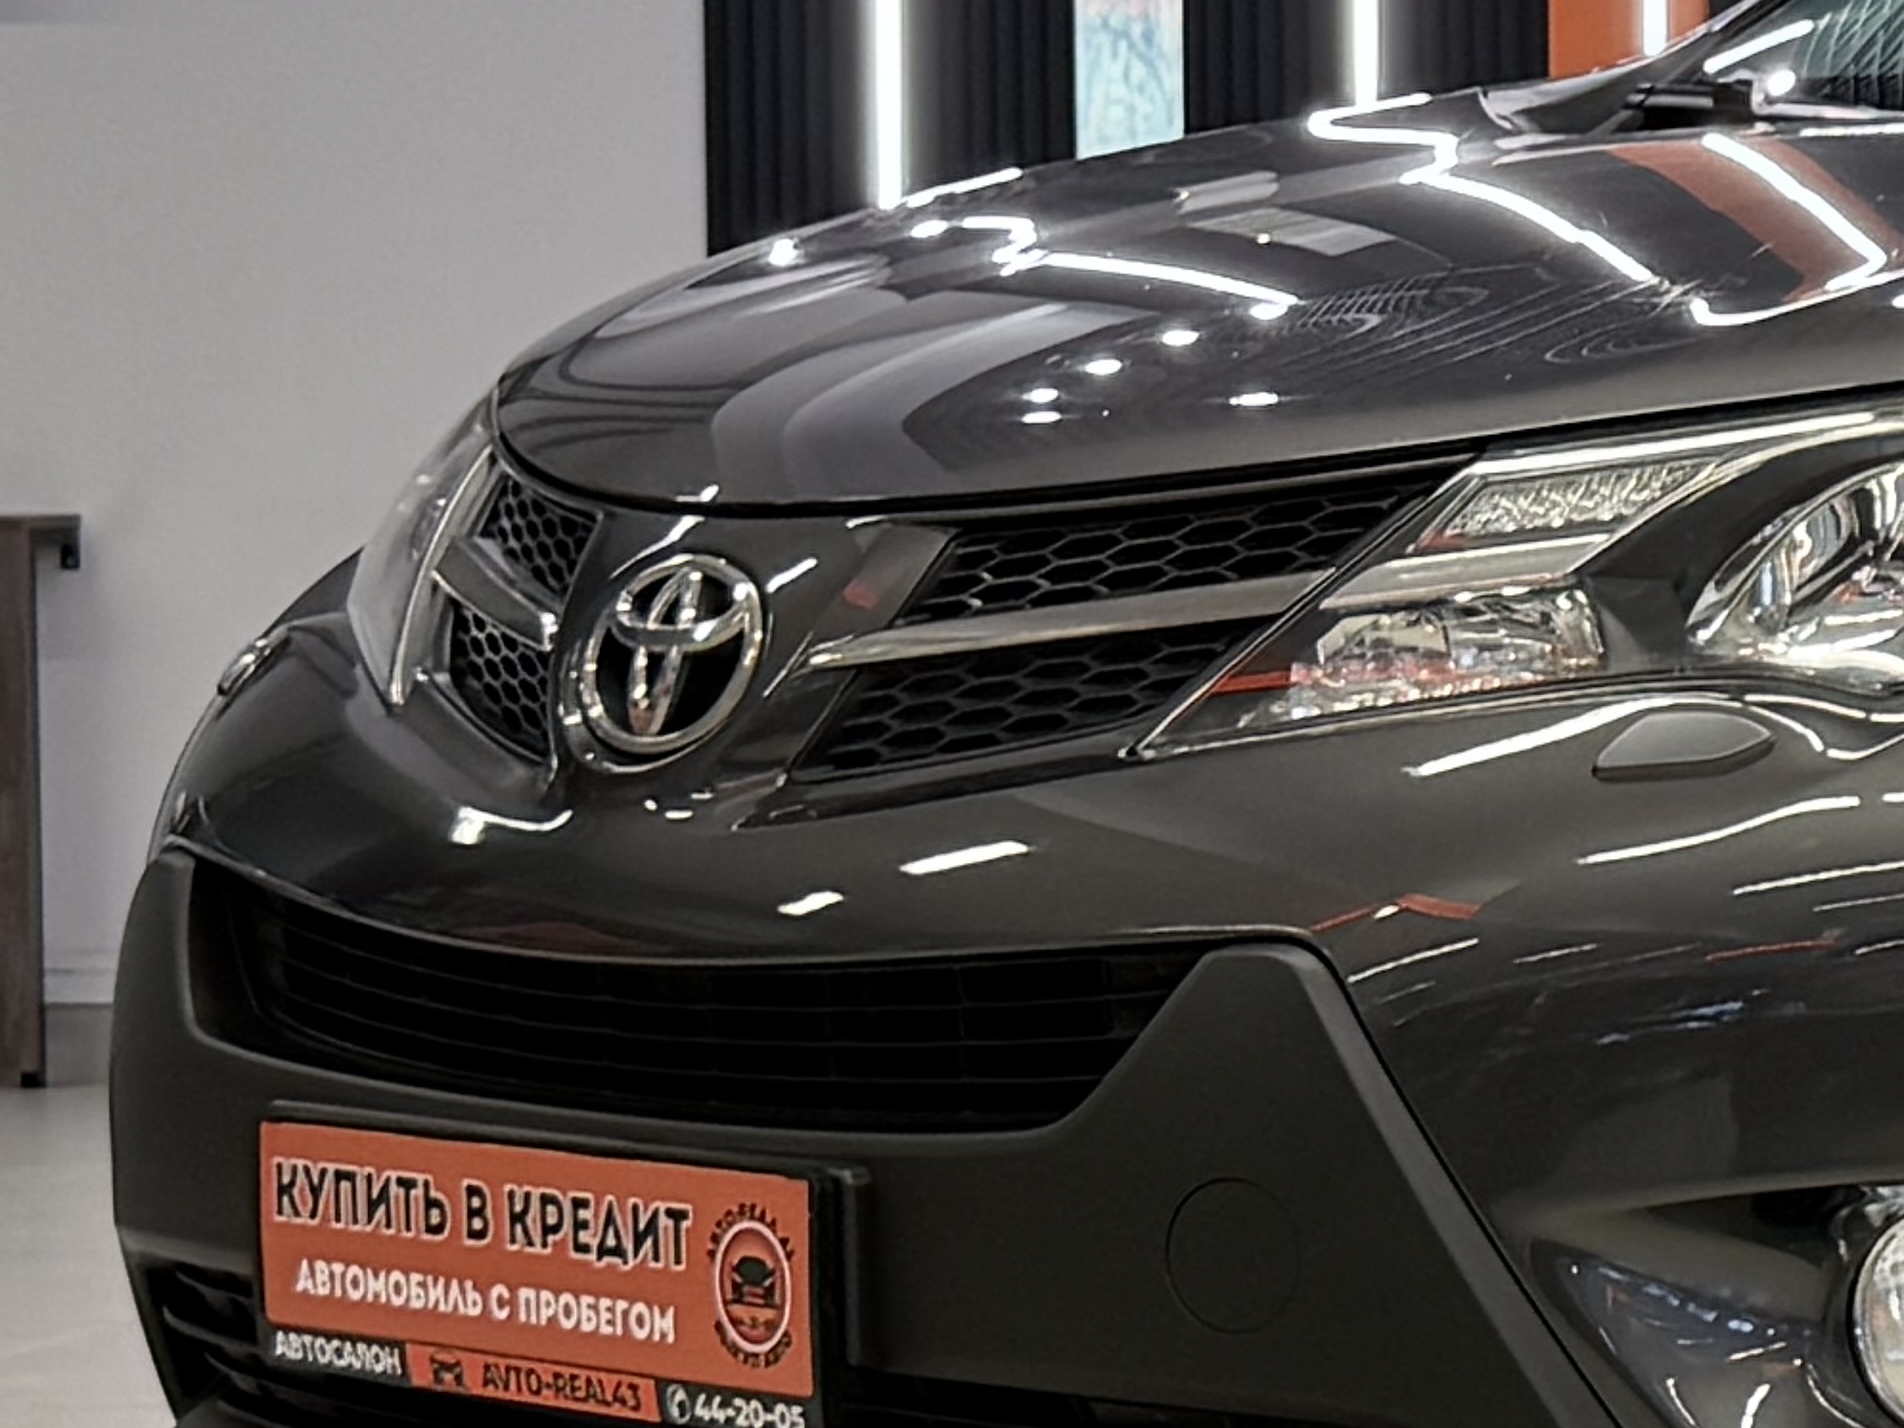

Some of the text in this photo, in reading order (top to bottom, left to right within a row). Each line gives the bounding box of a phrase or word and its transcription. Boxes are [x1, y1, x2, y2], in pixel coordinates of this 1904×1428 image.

[274, 1158, 451, 1240] КУПИТЬ
[462, 1178, 492, 1245] В
[503, 1183, 692, 1270] КРЕДИТ
[296, 1259, 675, 1343] АВТОМОБИЛЬ С ПРОБЕГОМ
[275, 1330, 402, 1375] АВТОСАЛОН
[482, 1362, 641, 1412] AVTO-REAL43
